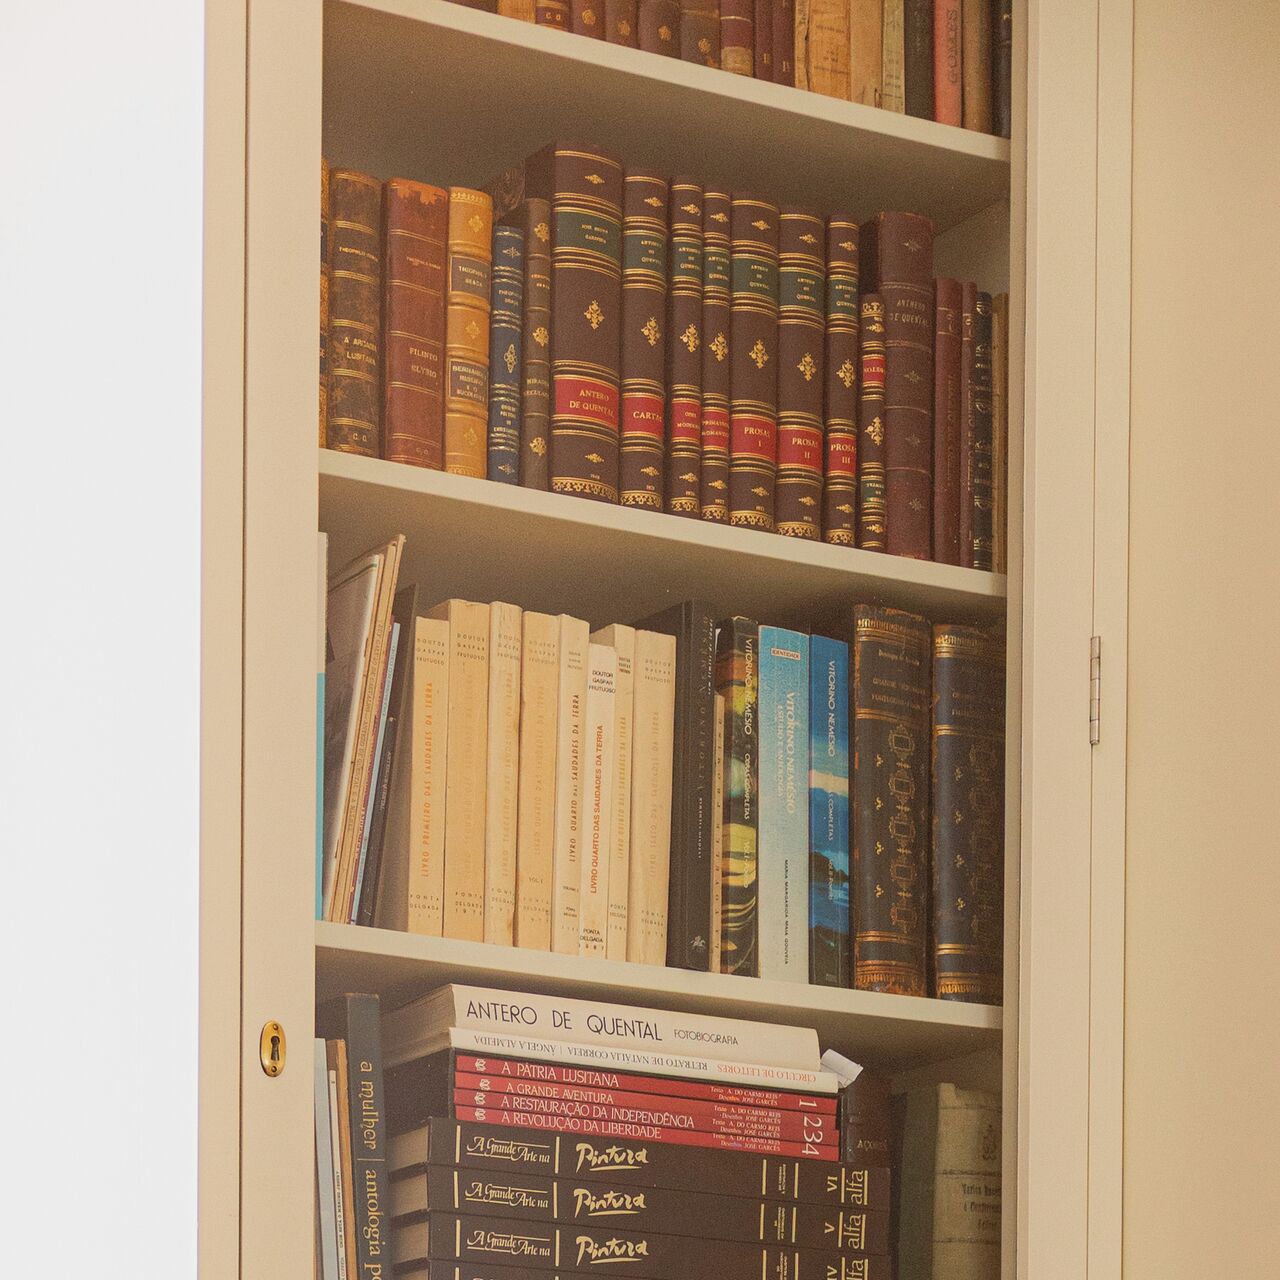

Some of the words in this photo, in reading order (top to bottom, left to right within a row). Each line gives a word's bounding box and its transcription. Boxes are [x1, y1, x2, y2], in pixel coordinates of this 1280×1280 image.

[579, 389, 609, 401] ANTERO
[569, 401, 580, 409] DE
[745, 639, 753, 688] VITORINO
[592, 670, 614, 678] DOUTOR
[593, 678, 613, 686] GASPAR
[589, 685, 616, 694] FRUTUOSO
[596, 725, 604, 752] TERRA
[596, 754, 603, 766] DA
[593, 767, 602, 814] SAUDADES
[592, 833, 600, 867] QUARTO
[590, 869, 599, 894] LIVRO
[467, 1001, 537, 1025] ANTERO
[552, 1010, 572, 1030] DE
[587, 1014, 662, 1041] QUENTAL
[674, 1029, 739, 1045] FOTOBIOGRAFIA
[474, 1035, 515, 1048] ALMEIDA
[568, 1046, 609, 1059] CORREIA
[360, 1061, 373, 1073] a
[653, 1056, 664, 1065] DE
[666, 1058, 708, 1071] RETRATO
[502, 1062, 511, 1075] A
[517, 1063, 557, 1080] PÁTRIA
[562, 1068, 619, 1088] LUSITANA
[717, 1064, 761, 1077] LEITORES
[764, 1070, 774, 1079] DE
[506, 1082, 514, 1093] A
[517, 1084, 559, 1097] GRANDE
[563, 1088, 614, 1105] AVENTURA
[799, 1099, 817, 1107] 1
[358, 1081, 379, 1150] mulher
[501, 1096, 510, 1108] A
[512, 1096, 590, 1117] RESTAURAÇÃO
[592, 1105, 609, 1119] DA
[611, 1108, 695, 1129] INDEPENDÊNCIA
[502, 1112, 510, 1124] A
[513, 1112, 581, 1131] REVOLUÇÃO
[584, 1120, 601, 1133] DA
[601, 1123, 662, 1139] LIBERDADE
[804, 1116, 822, 1127] 2
[804, 1131, 823, 1142] 3
[467, 1136, 485, 1152] A
[486, 1138, 517, 1157] Grande
[510, 1146, 537, 1162] Arte
[538, 1154, 550, 1164] na
[802, 1144, 820, 1155] 4
[576, 1143, 649, 1173] Pintura
[364, 1170, 385, 1256] antologia
